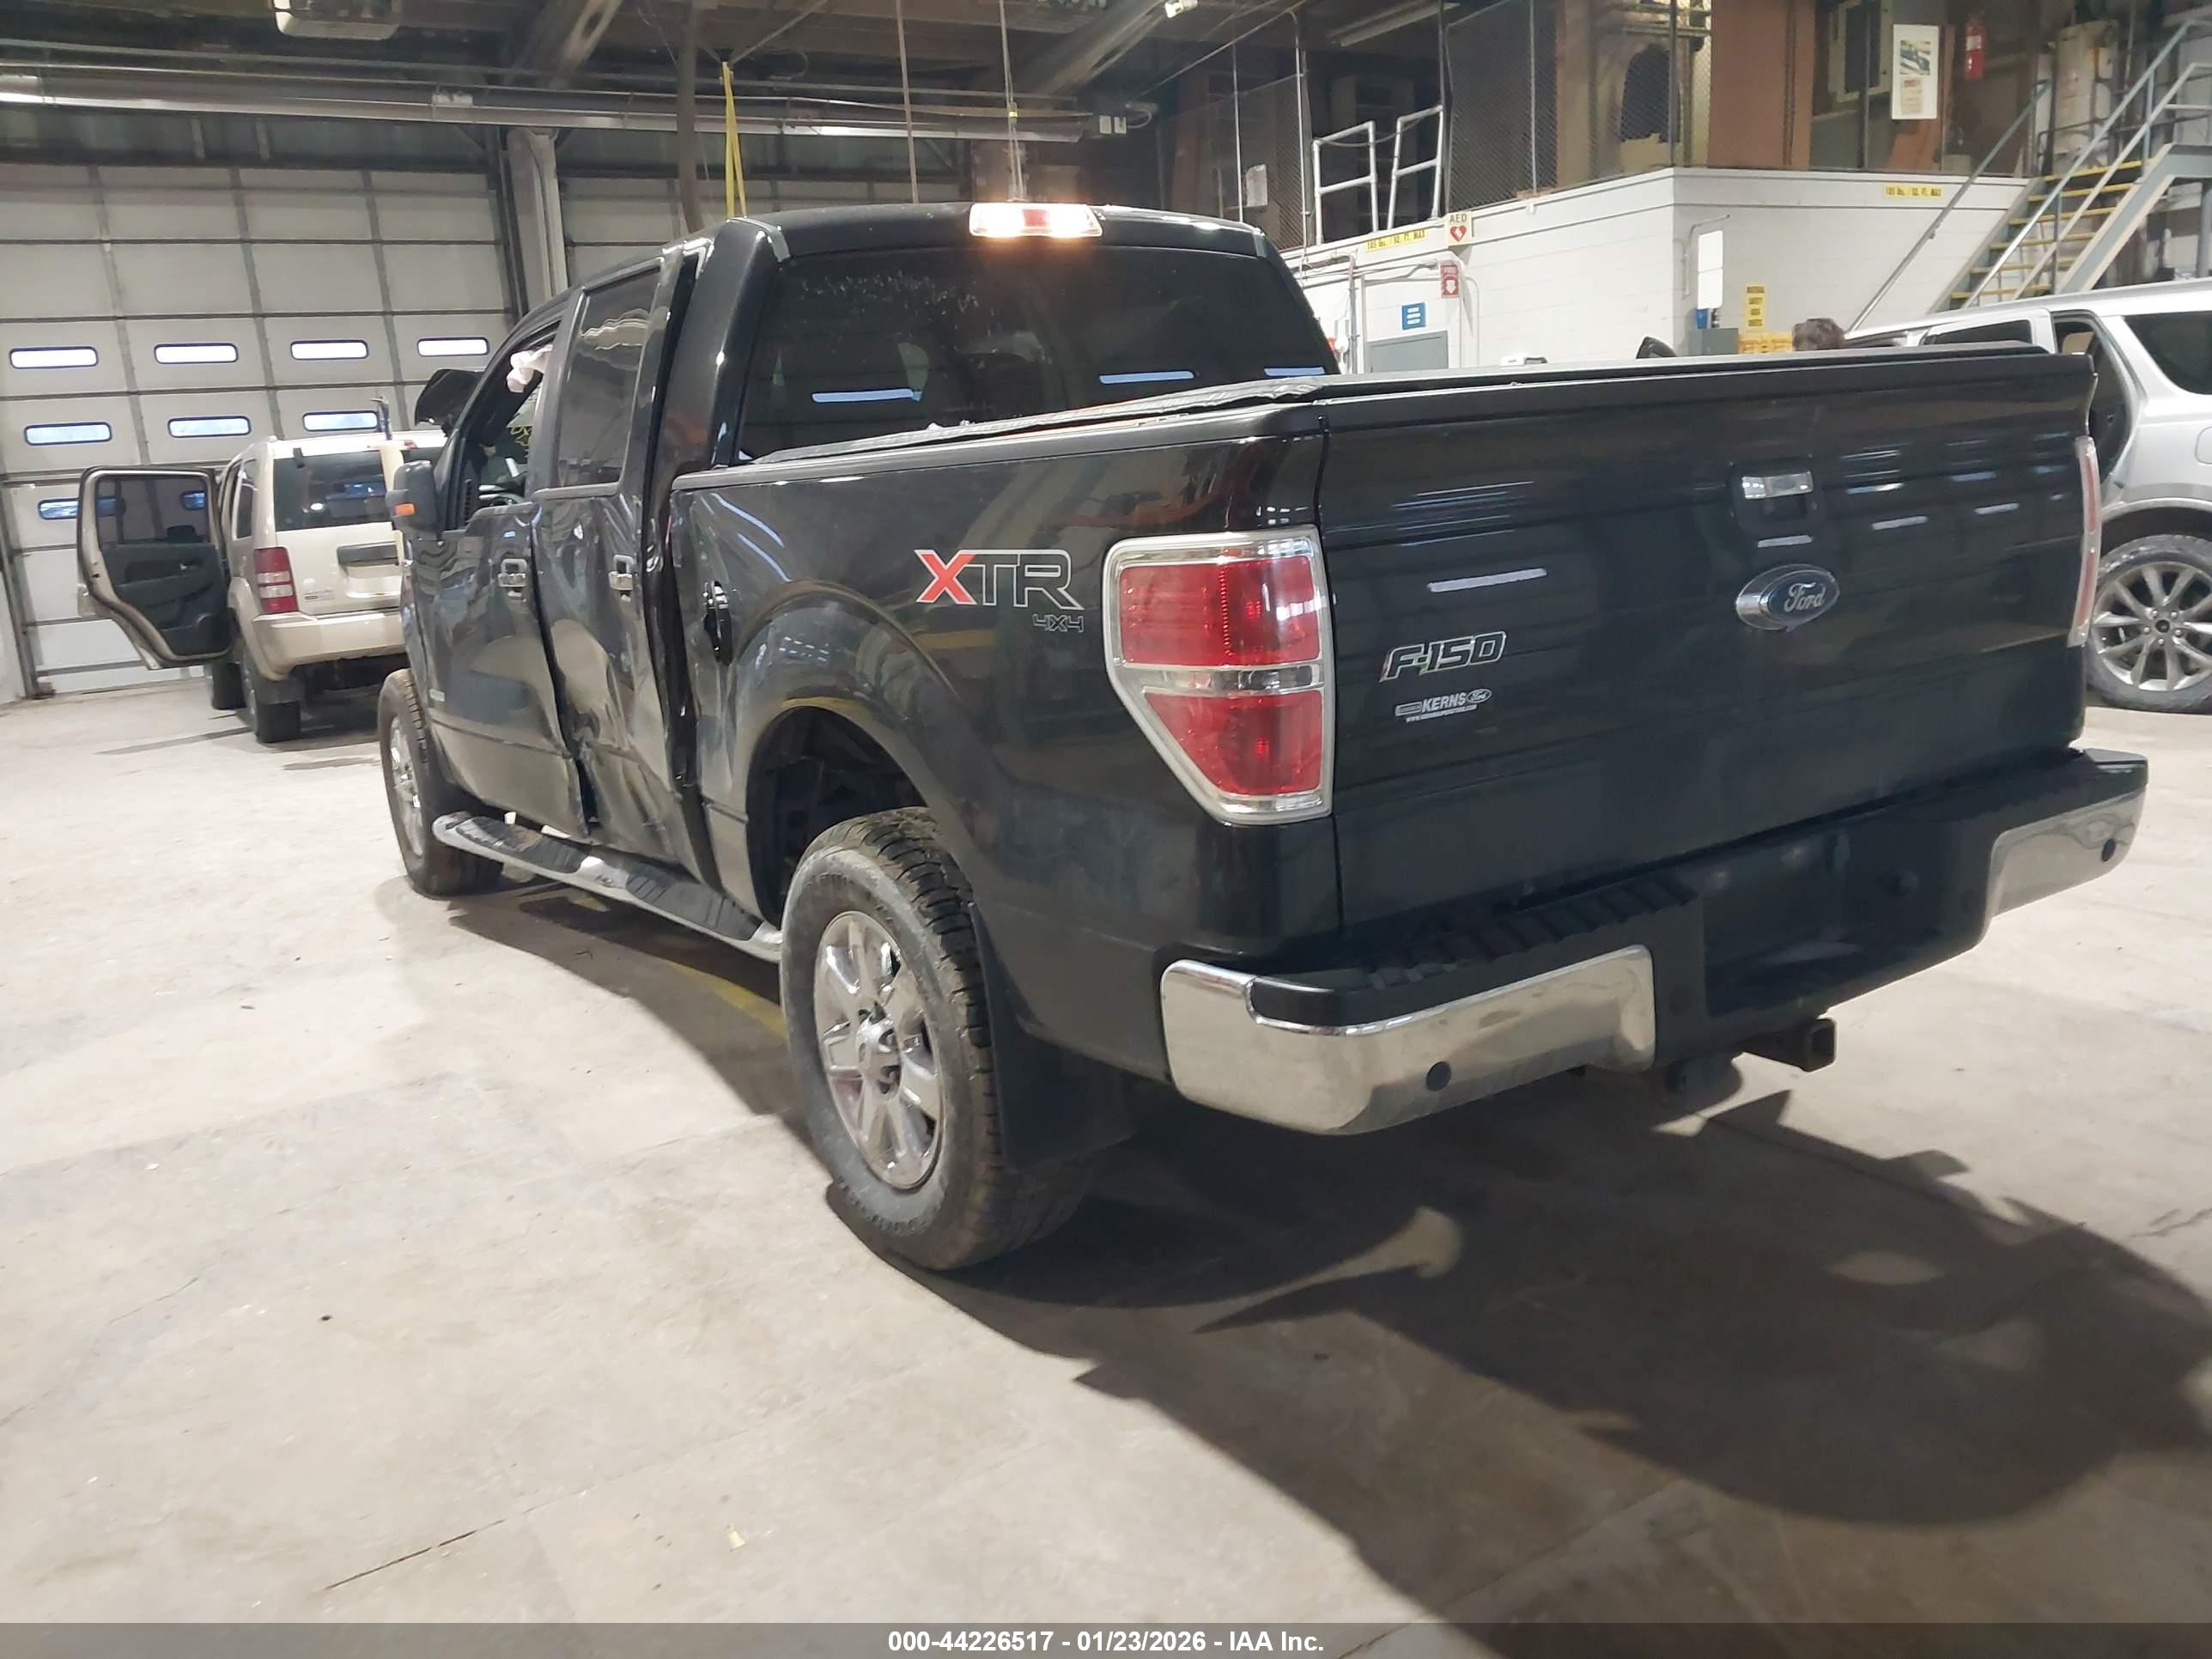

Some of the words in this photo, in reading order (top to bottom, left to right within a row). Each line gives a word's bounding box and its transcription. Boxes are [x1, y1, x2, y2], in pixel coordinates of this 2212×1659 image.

[1449, 213, 1468, 223] AED
[914, 549, 1085, 611] XTR
[1784, 581, 1827, 613] Ford
[1379, 630, 1507, 683] F-150
[1422, 692, 1468, 714] KERNS
